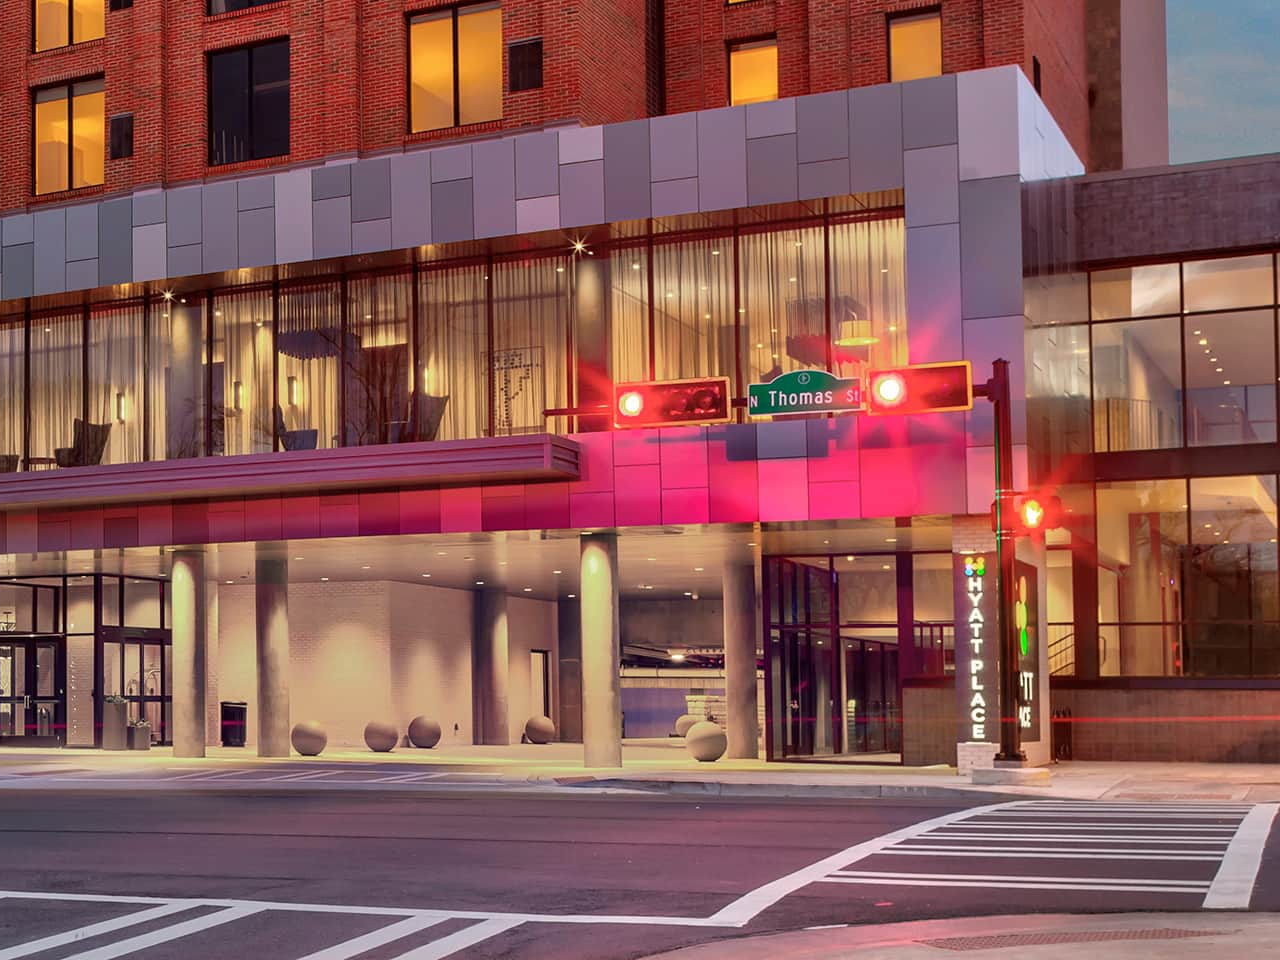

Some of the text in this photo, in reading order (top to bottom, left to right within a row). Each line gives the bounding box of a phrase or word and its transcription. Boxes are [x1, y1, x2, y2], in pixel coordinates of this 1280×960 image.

[750, 389, 859, 408] N Thomas St
[968, 577, 986, 739] HYATT PLACE
